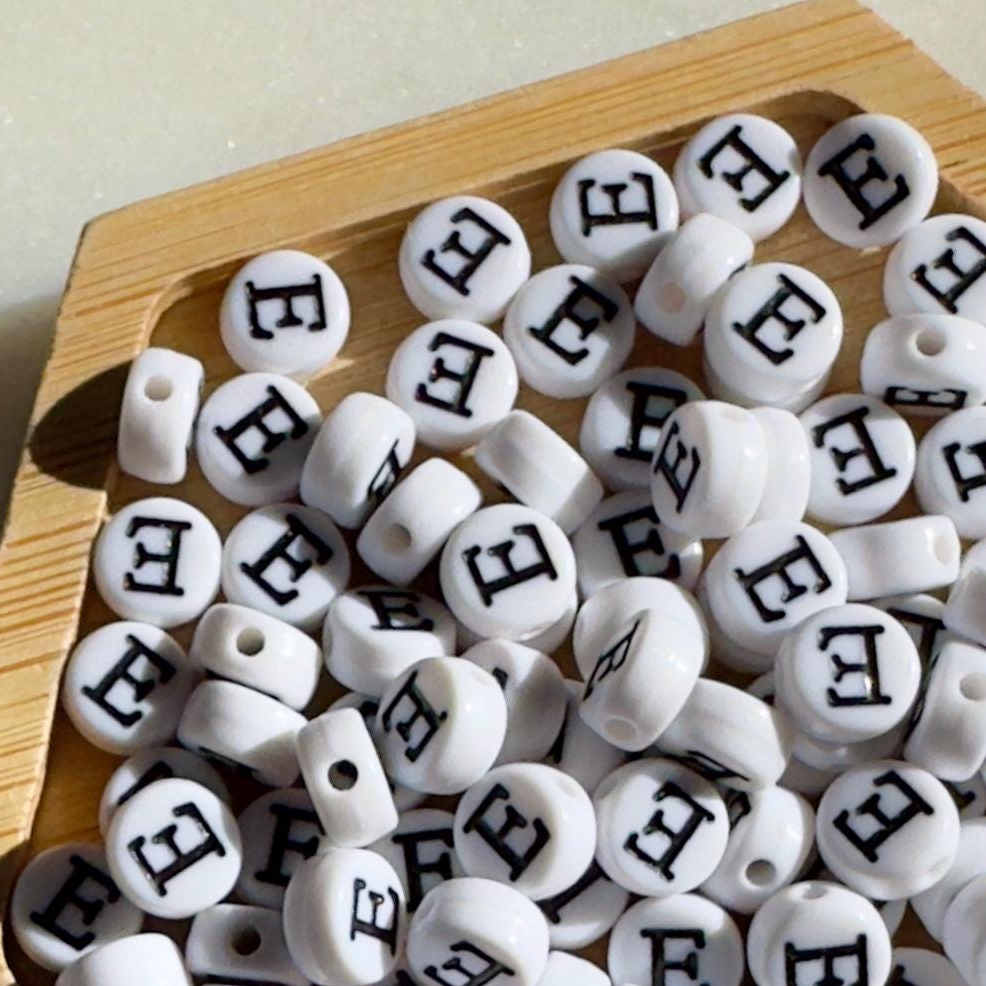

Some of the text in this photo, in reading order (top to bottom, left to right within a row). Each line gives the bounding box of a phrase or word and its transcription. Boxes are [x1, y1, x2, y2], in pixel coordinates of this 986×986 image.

[578, 172, 658, 238] E
[697, 125, 790, 213] E
[818, 133, 911, 231] E
[421, 207, 511, 296] E
[912, 226, 986, 314] E
[245, 274, 327, 339] E
[527, 275, 619, 367] E
[732, 273, 827, 366] E
[416, 332, 494, 418] E
[214, 385, 308, 474] E
[654, 420, 701, 514] E
[811, 406, 897, 496] E
[124, 517, 192, 597] E
[240, 513, 334, 605] E
[462, 523, 558, 607] E
[598, 505, 681, 577] E
[734, 535, 832, 623] E
[356, 591, 433, 631] E
[82, 634, 177, 728] E
[819, 624, 892, 707] E
[382, 670, 448, 763] E
[127, 801, 226, 897] E
[463, 783, 551, 882] E
[623, 781, 716, 881] E
[833, 770, 935, 863] E
[30, 854, 121, 952] E
[350, 878, 400, 956] E
